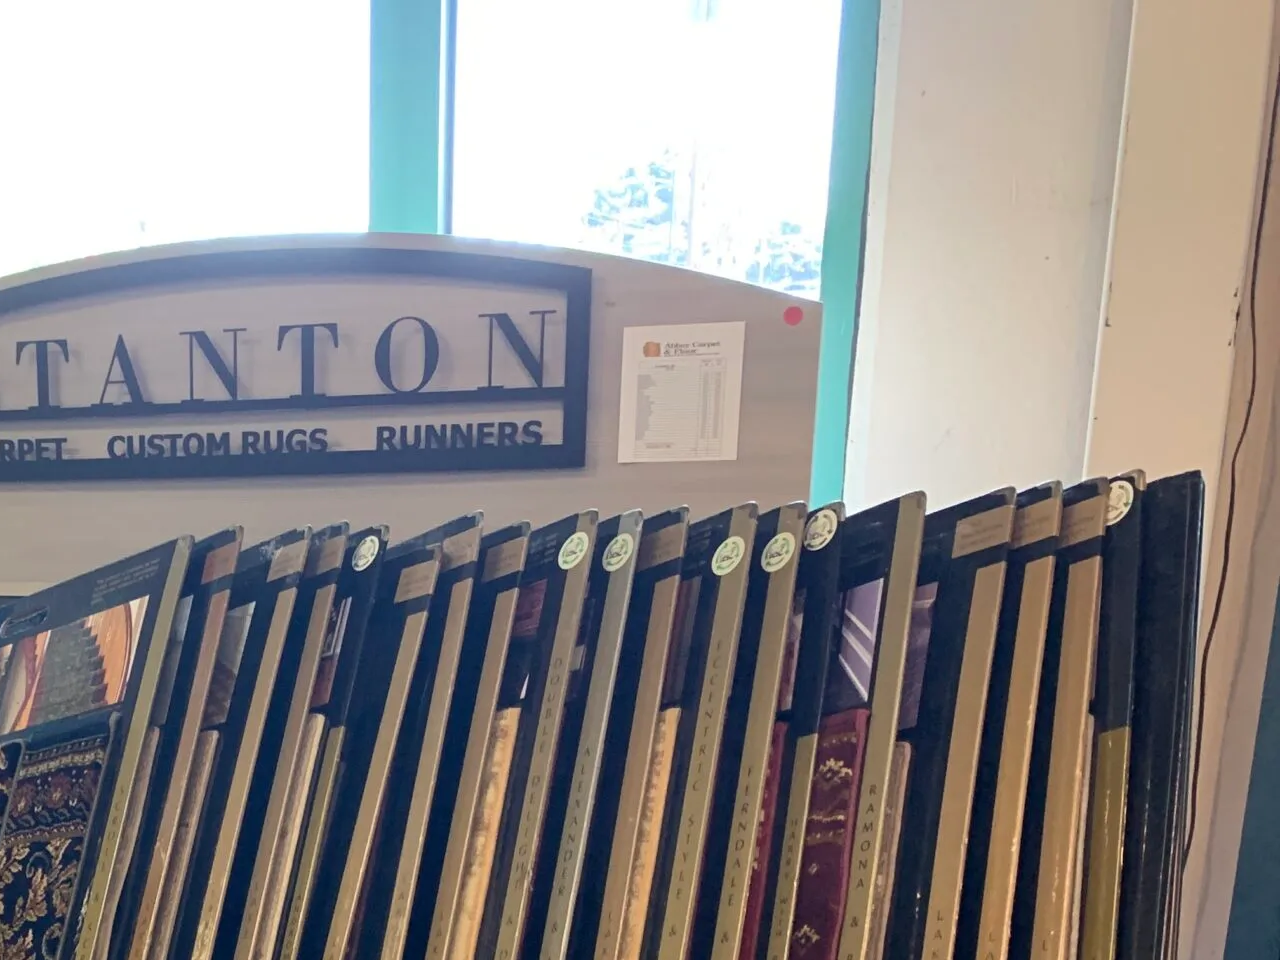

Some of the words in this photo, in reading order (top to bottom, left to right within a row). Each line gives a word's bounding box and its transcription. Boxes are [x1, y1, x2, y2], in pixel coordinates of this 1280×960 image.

[106, 431, 231, 459] CUSTOM
[241, 427, 329, 455] RUGS
[376, 420, 544, 450] RUNNERS
[540, 658, 562, 754] DOUBLE
[558, 745, 590, 897] ALEXANDER
[728, 767, 752, 913] FERNDALE
[856, 784, 877, 888] RAMONA
[850, 916, 859, 928] &
